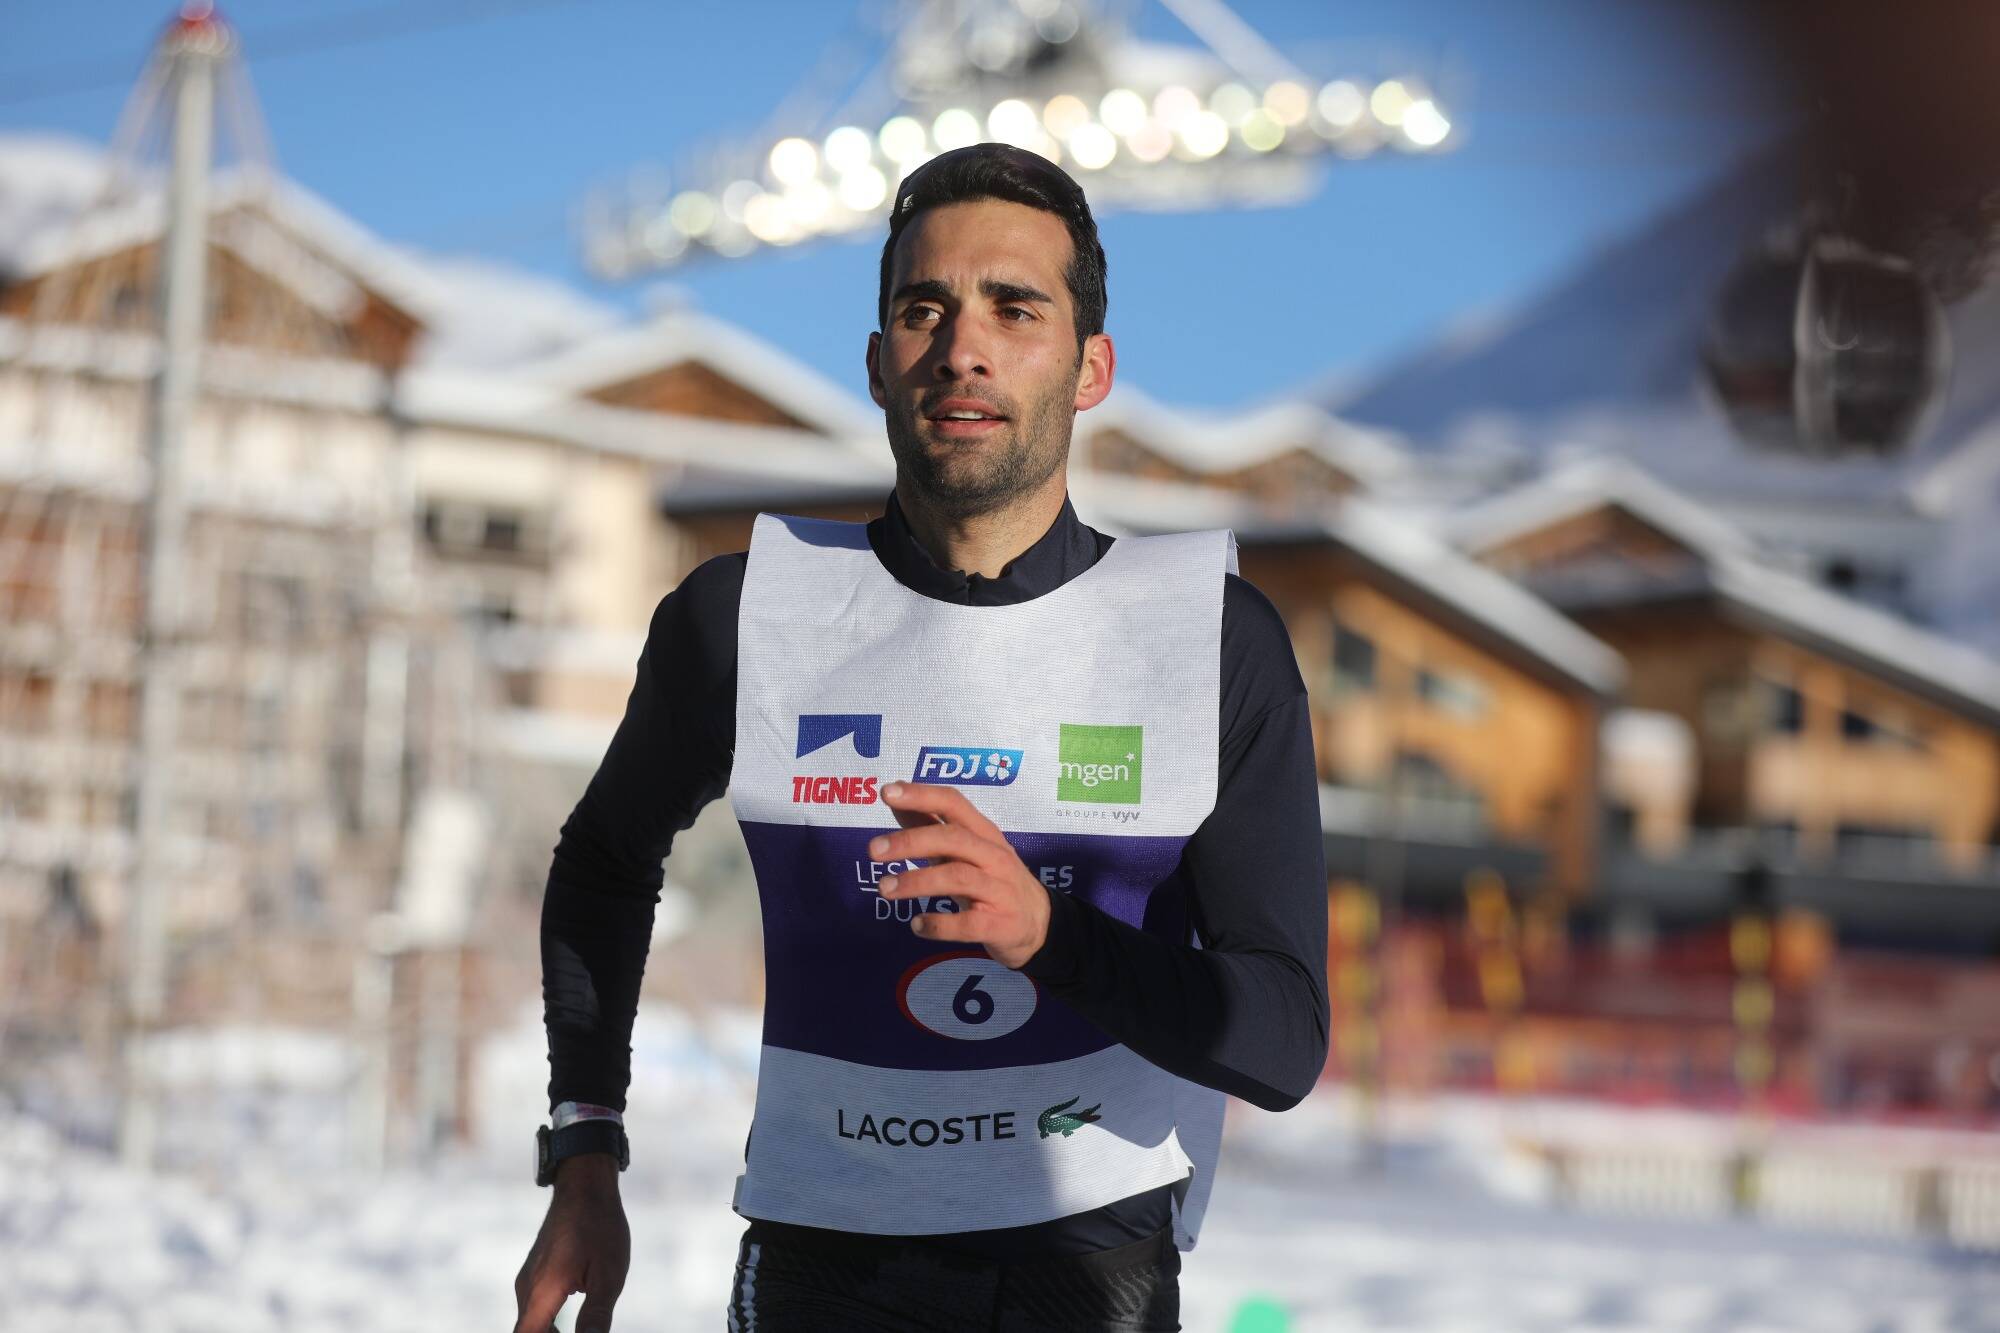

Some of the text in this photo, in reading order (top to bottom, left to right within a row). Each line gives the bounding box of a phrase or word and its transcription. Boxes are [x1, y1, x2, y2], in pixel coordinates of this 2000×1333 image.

[920, 753, 981, 779] FDJ
[1059, 762, 1129, 787] mgen
[792, 776, 878, 804] TIGNES
[1056, 809, 1140, 823] GROUPE vyv
[876, 897, 913, 922] DU
[952, 975, 995, 1025] 6
[838, 1109, 1016, 1147] LACOSTE
